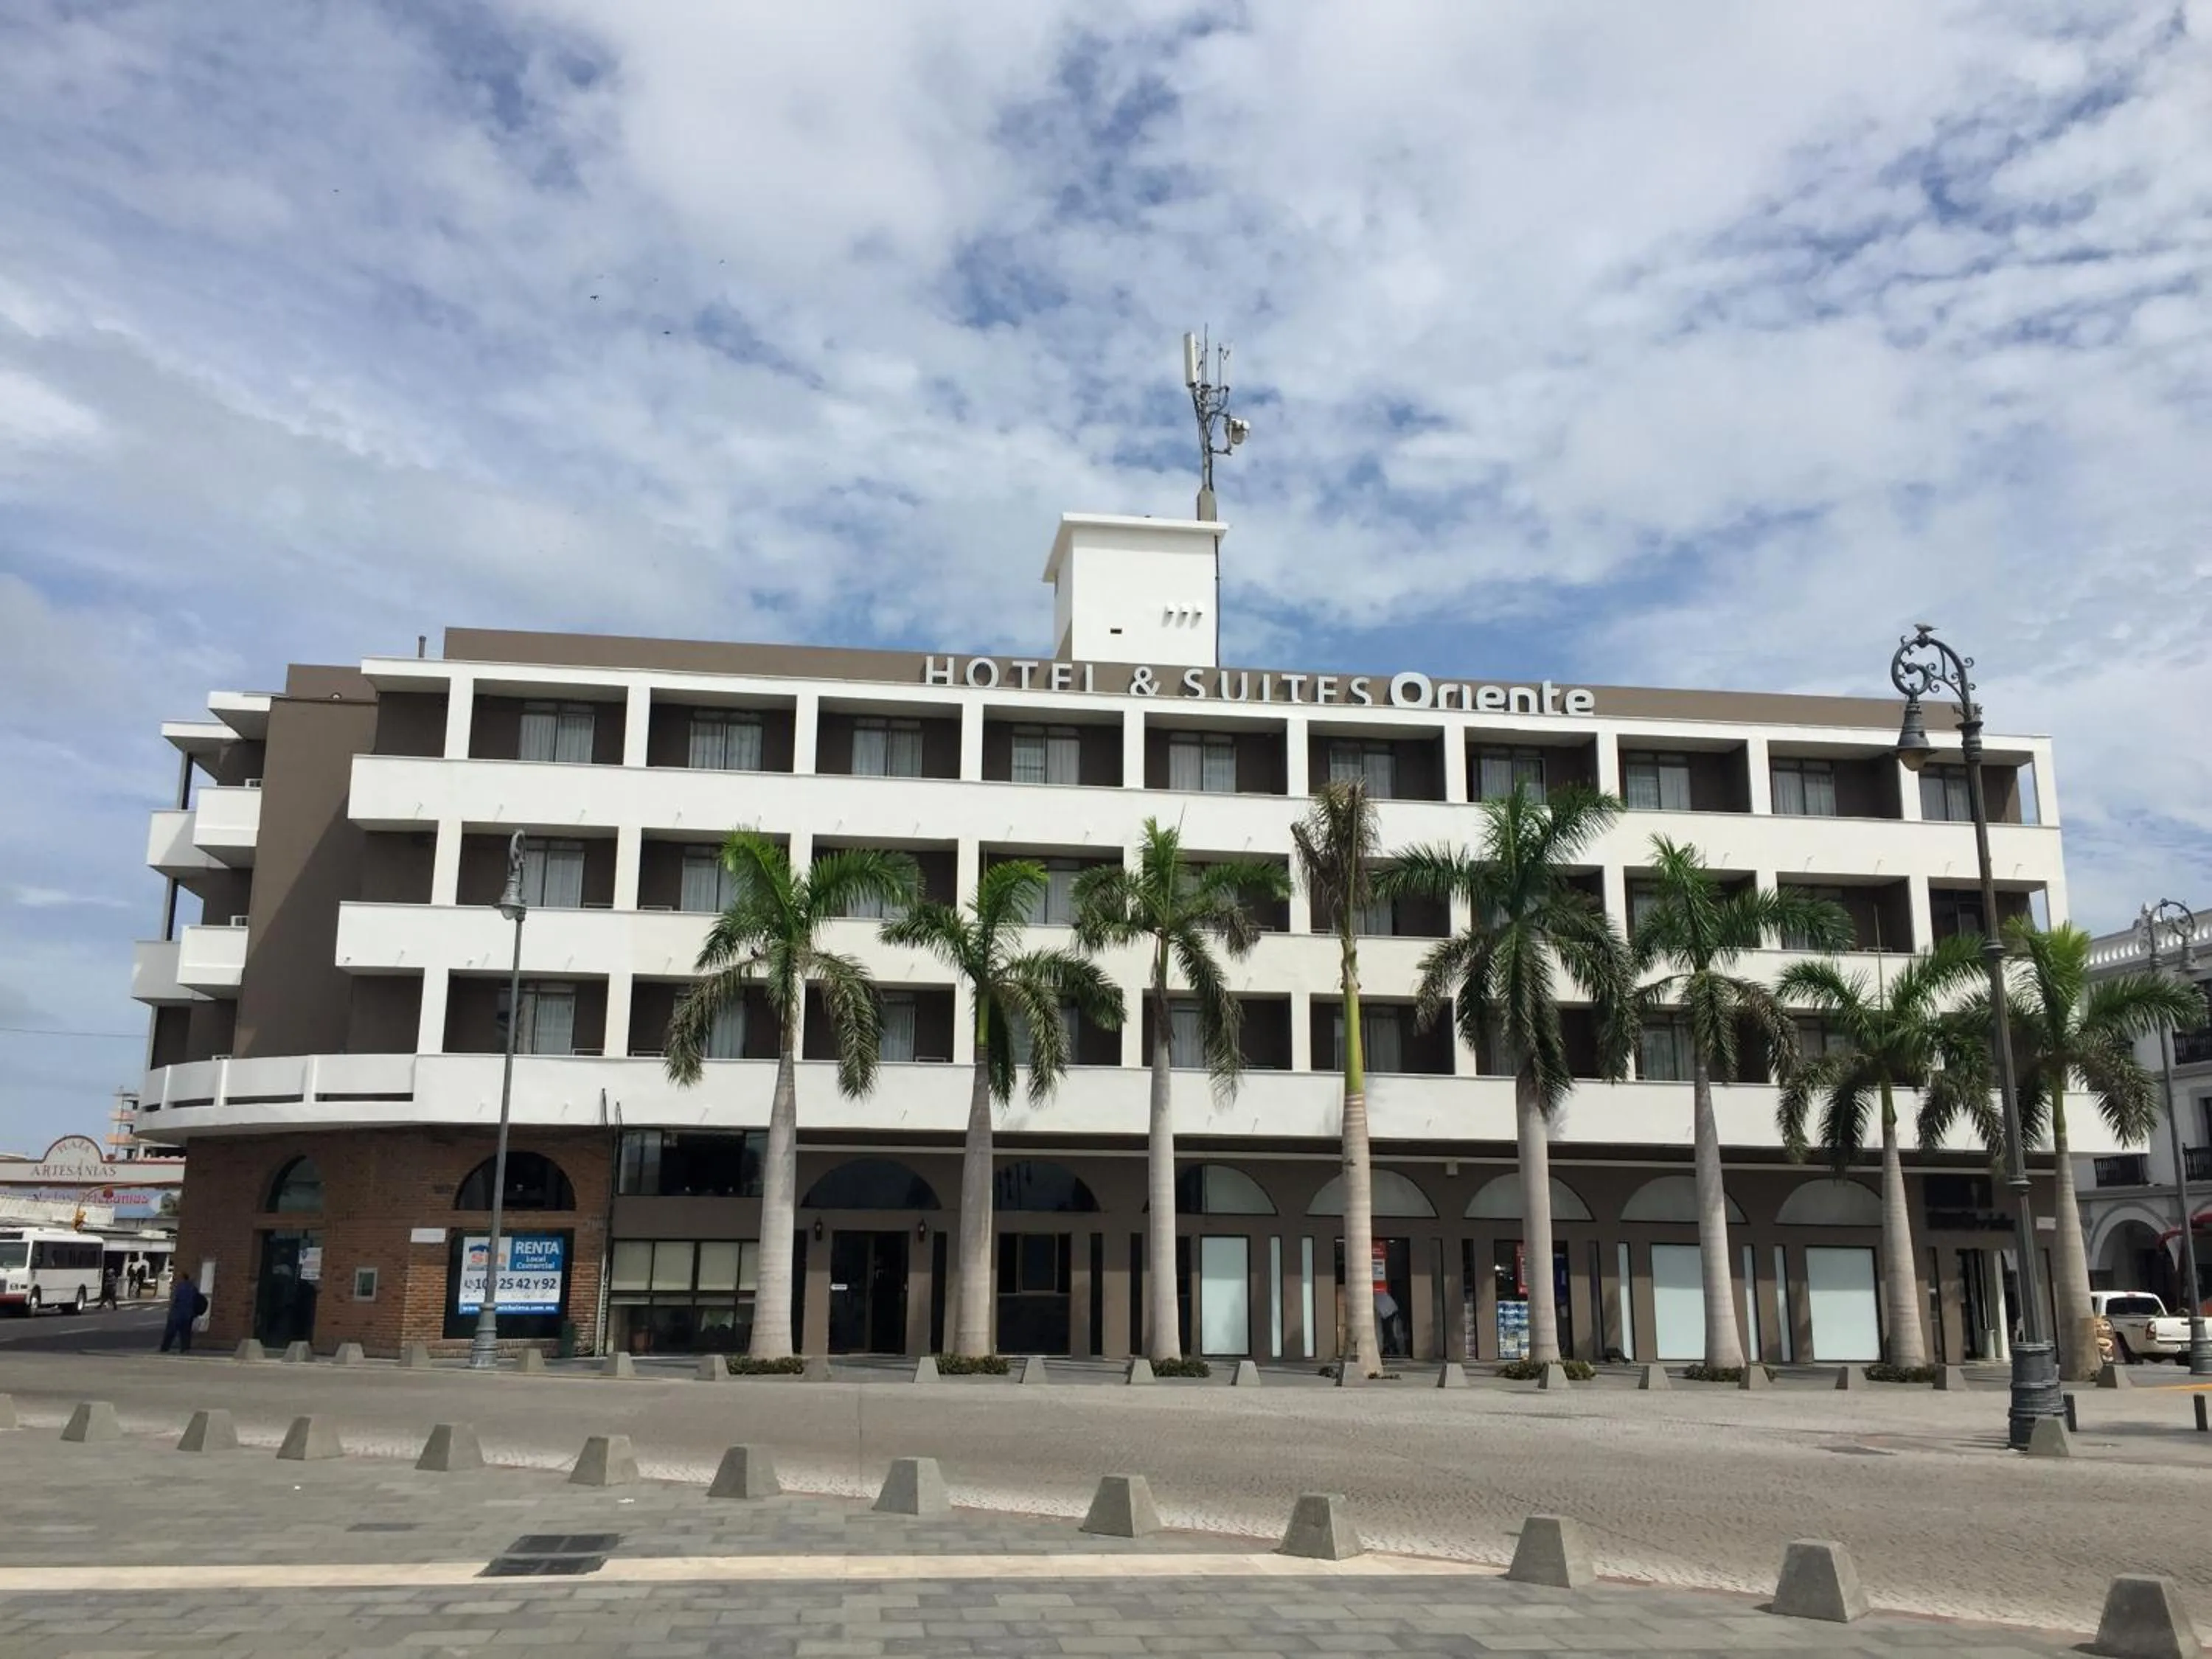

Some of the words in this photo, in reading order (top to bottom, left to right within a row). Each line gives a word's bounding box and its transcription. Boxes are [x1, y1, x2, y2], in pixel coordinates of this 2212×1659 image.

[925, 655, 1093, 693] HOTEL
[1129, 666, 1161, 696] &
[1183, 668, 1372, 706] SUITES
[1390, 672, 1595, 716] Oriente
[30, 1164, 116, 1178] ARTESANIAS
[515, 1241, 560, 1254] RENTA
[526, 1254, 546, 1262] Local
[516, 1262, 555, 1270] Comercial
[499, 1278, 514, 1290] 25
[516, 1278, 530, 1290] 42
[533, 1279, 540, 1290] Y
[542, 1278, 557, 1290] 92
